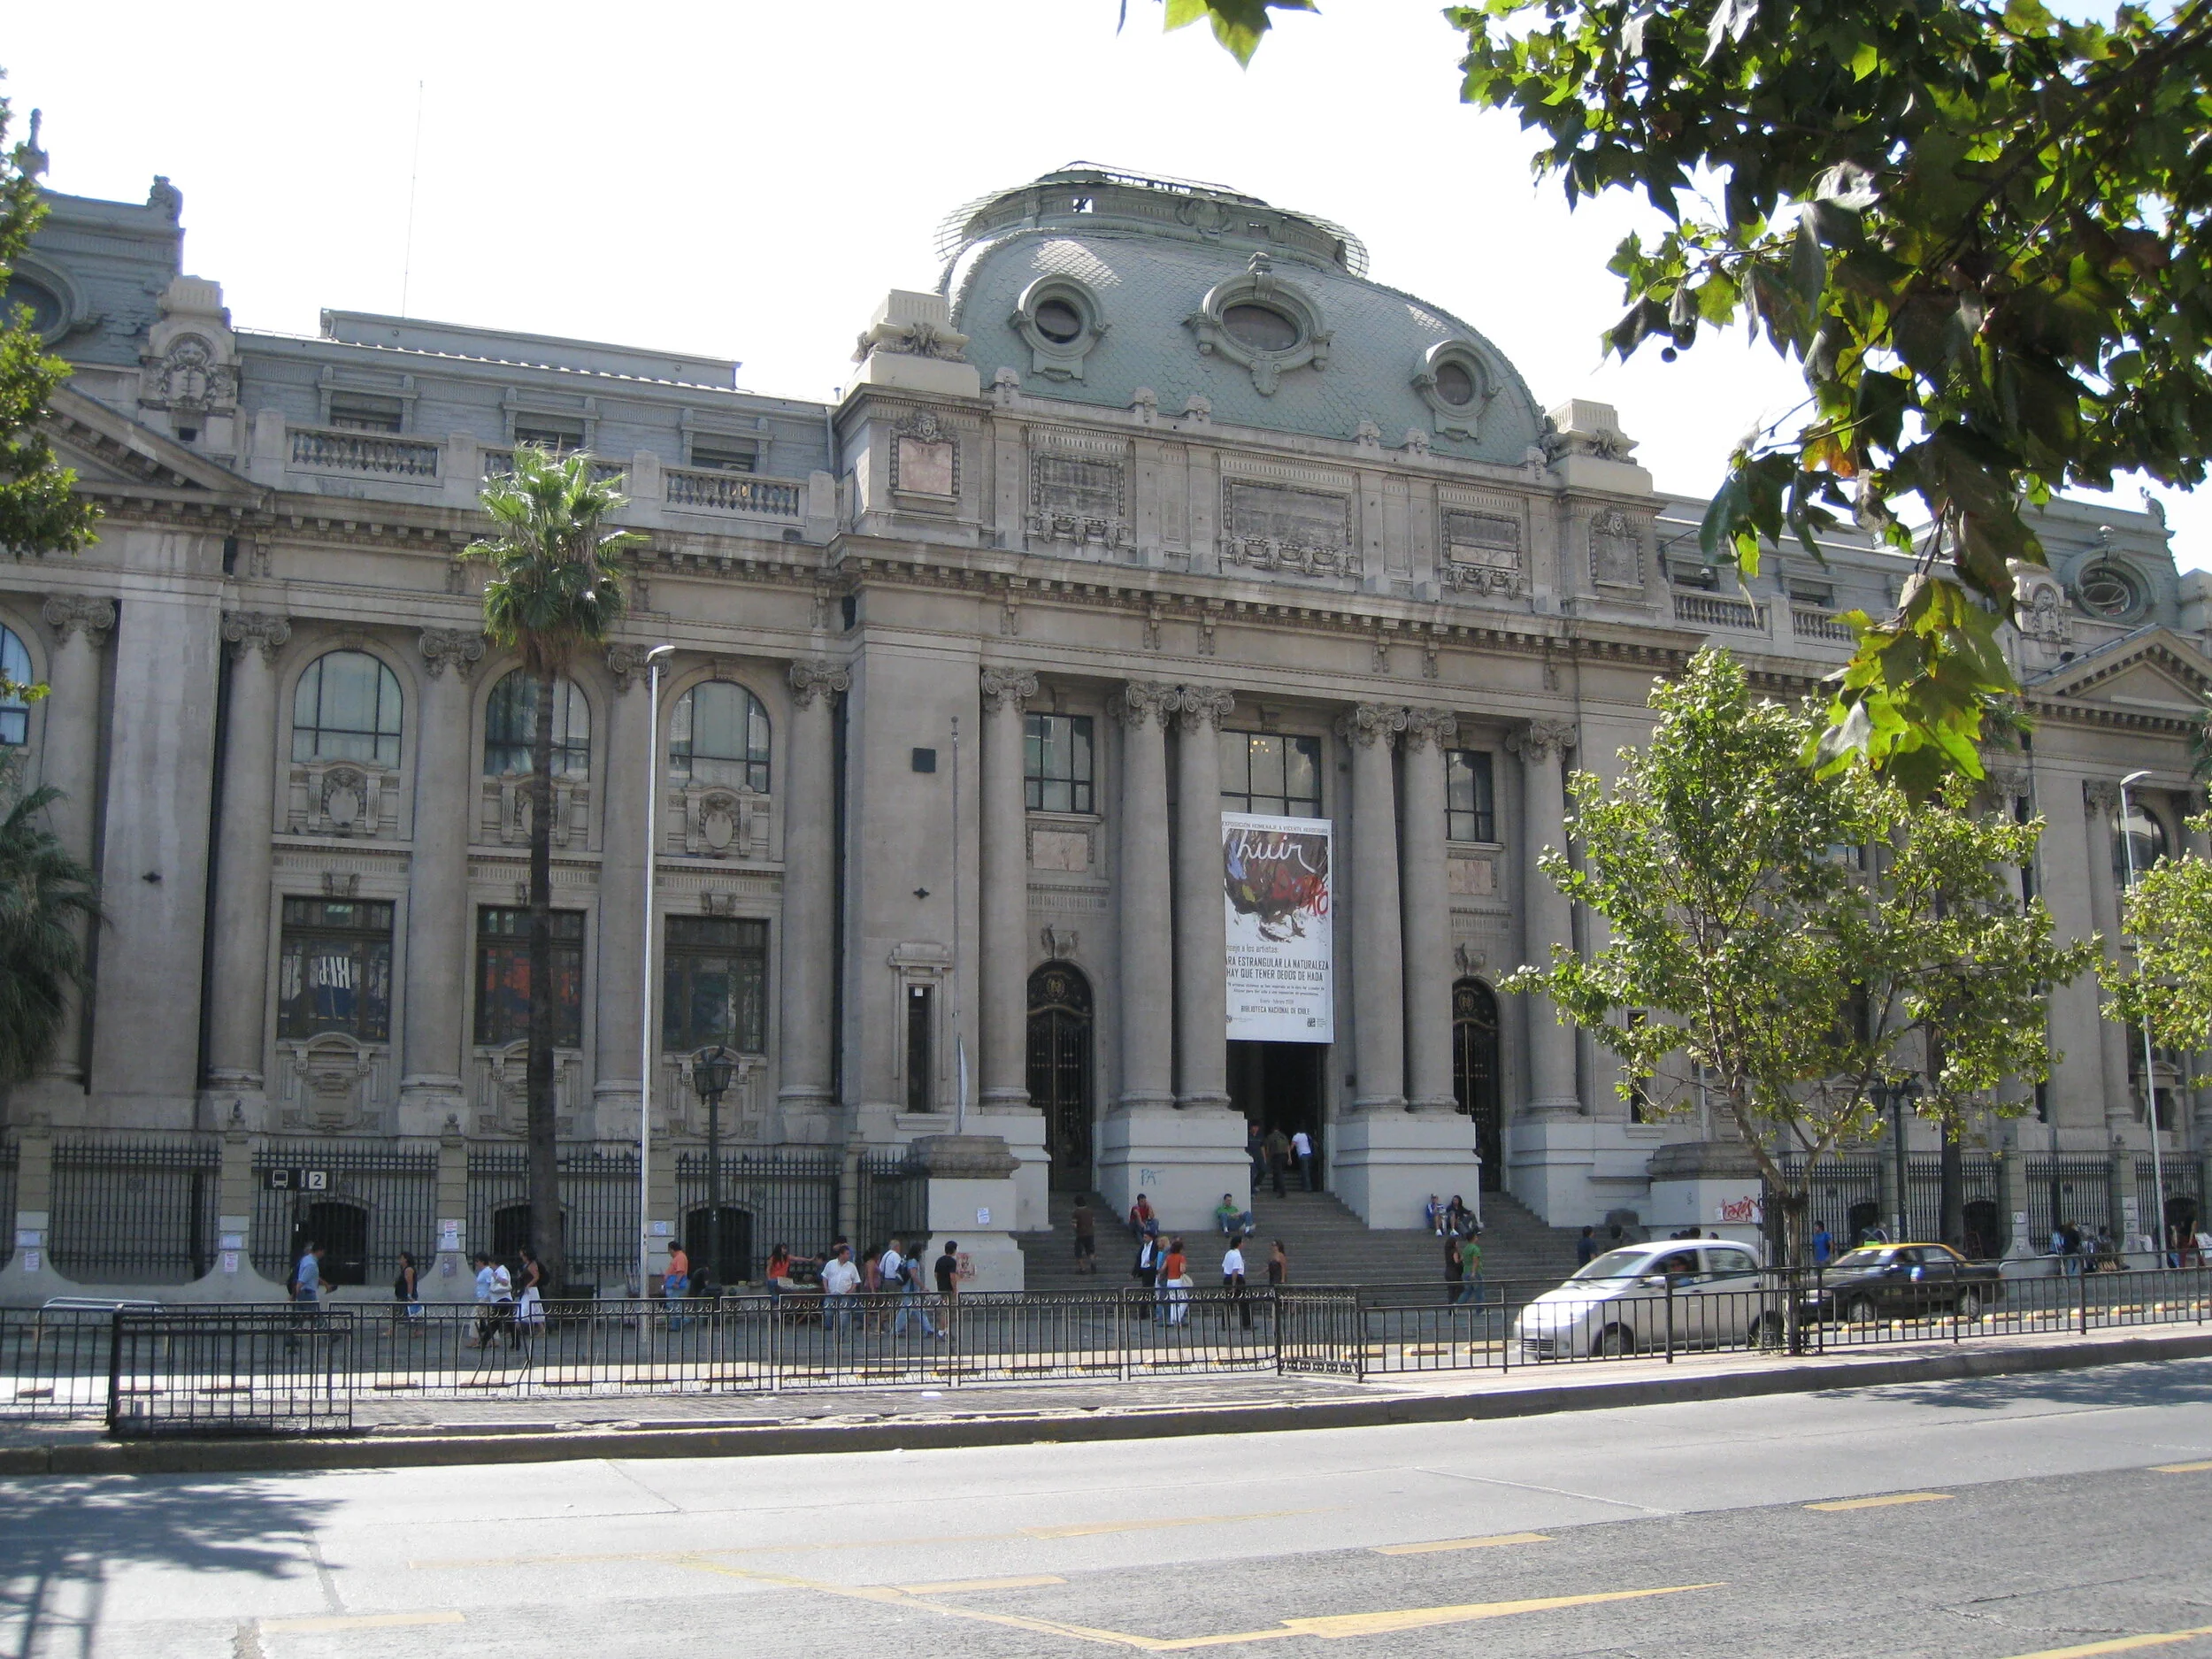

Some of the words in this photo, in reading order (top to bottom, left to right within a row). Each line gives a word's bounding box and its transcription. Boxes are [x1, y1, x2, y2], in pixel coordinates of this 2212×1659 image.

[1239, 956, 1283, 968] ESTRANGULAR
[1284, 958, 1292, 968] LA
[1293, 959, 1329, 970] NATURALEZA
[1226, 968, 1239, 978] HAY
[1240, 969, 1253, 978] QUE
[1256, 969, 1275, 979] TENER
[1298, 971, 1305, 980] DE
[1307, 972, 1324, 981] HADA
[313, 1174, 322, 1187] 2
